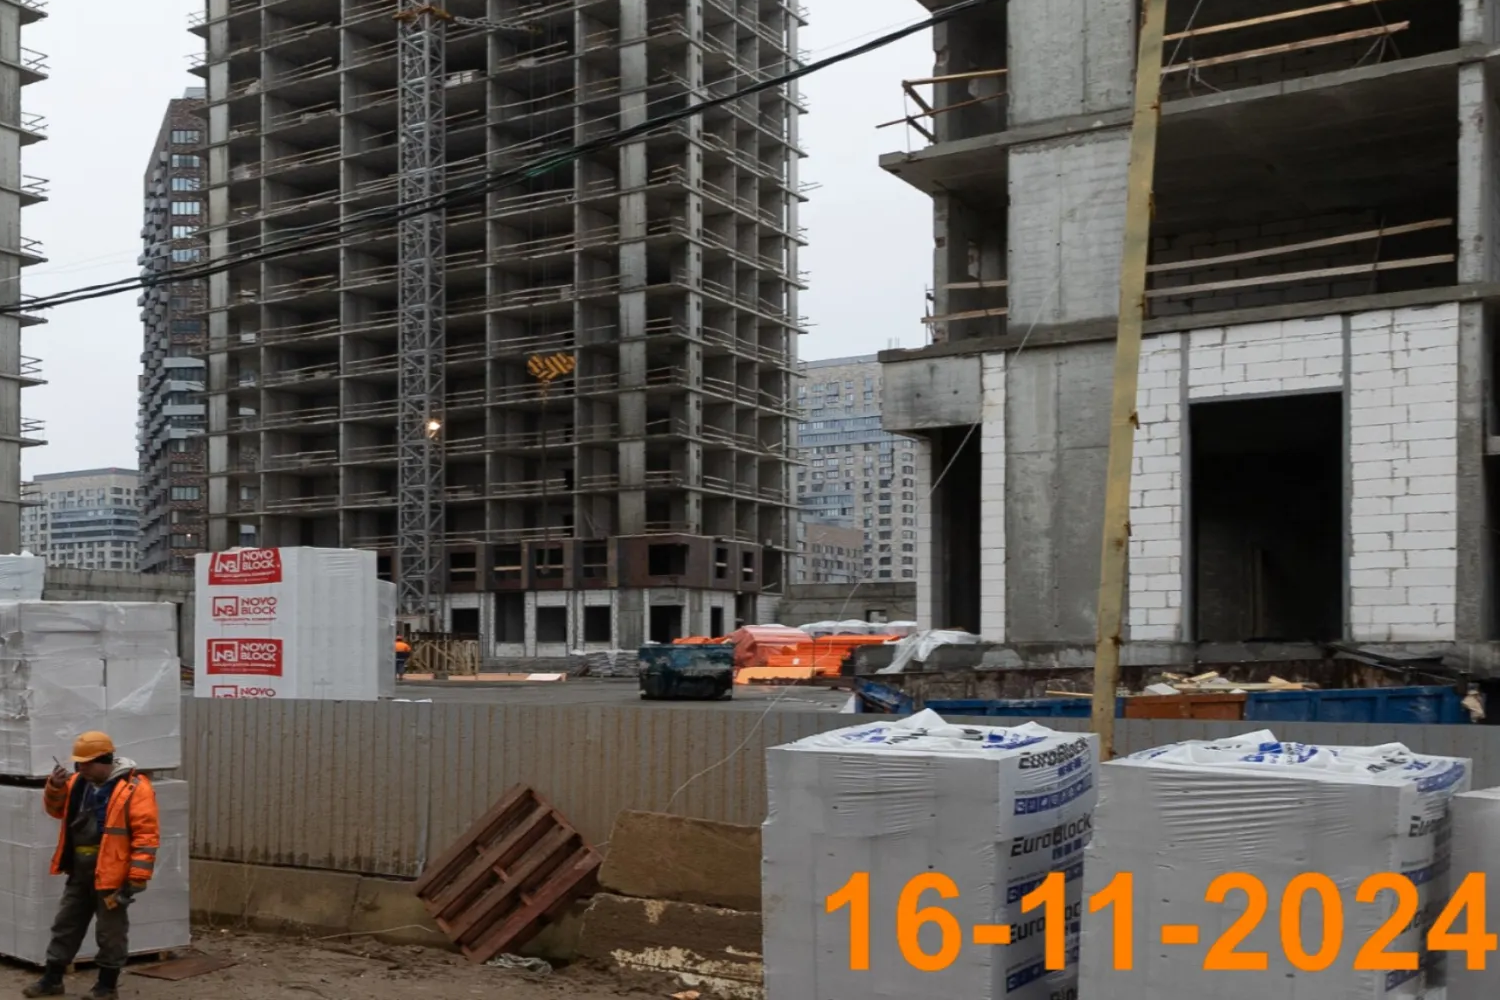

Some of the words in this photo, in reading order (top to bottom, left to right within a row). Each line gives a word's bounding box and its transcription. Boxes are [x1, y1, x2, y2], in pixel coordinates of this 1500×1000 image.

[242, 550, 274, 561] NOVO
[242, 559, 275, 570] BLOCK
[241, 597, 277, 606] NOVO
[241, 606, 277, 615] BLOCK
[240, 643, 277, 652] NOVO
[240, 652, 277, 661] BLOCK
[240, 687, 276, 697] NOVO
[1010, 812, 1092, 857] EuroBlock
